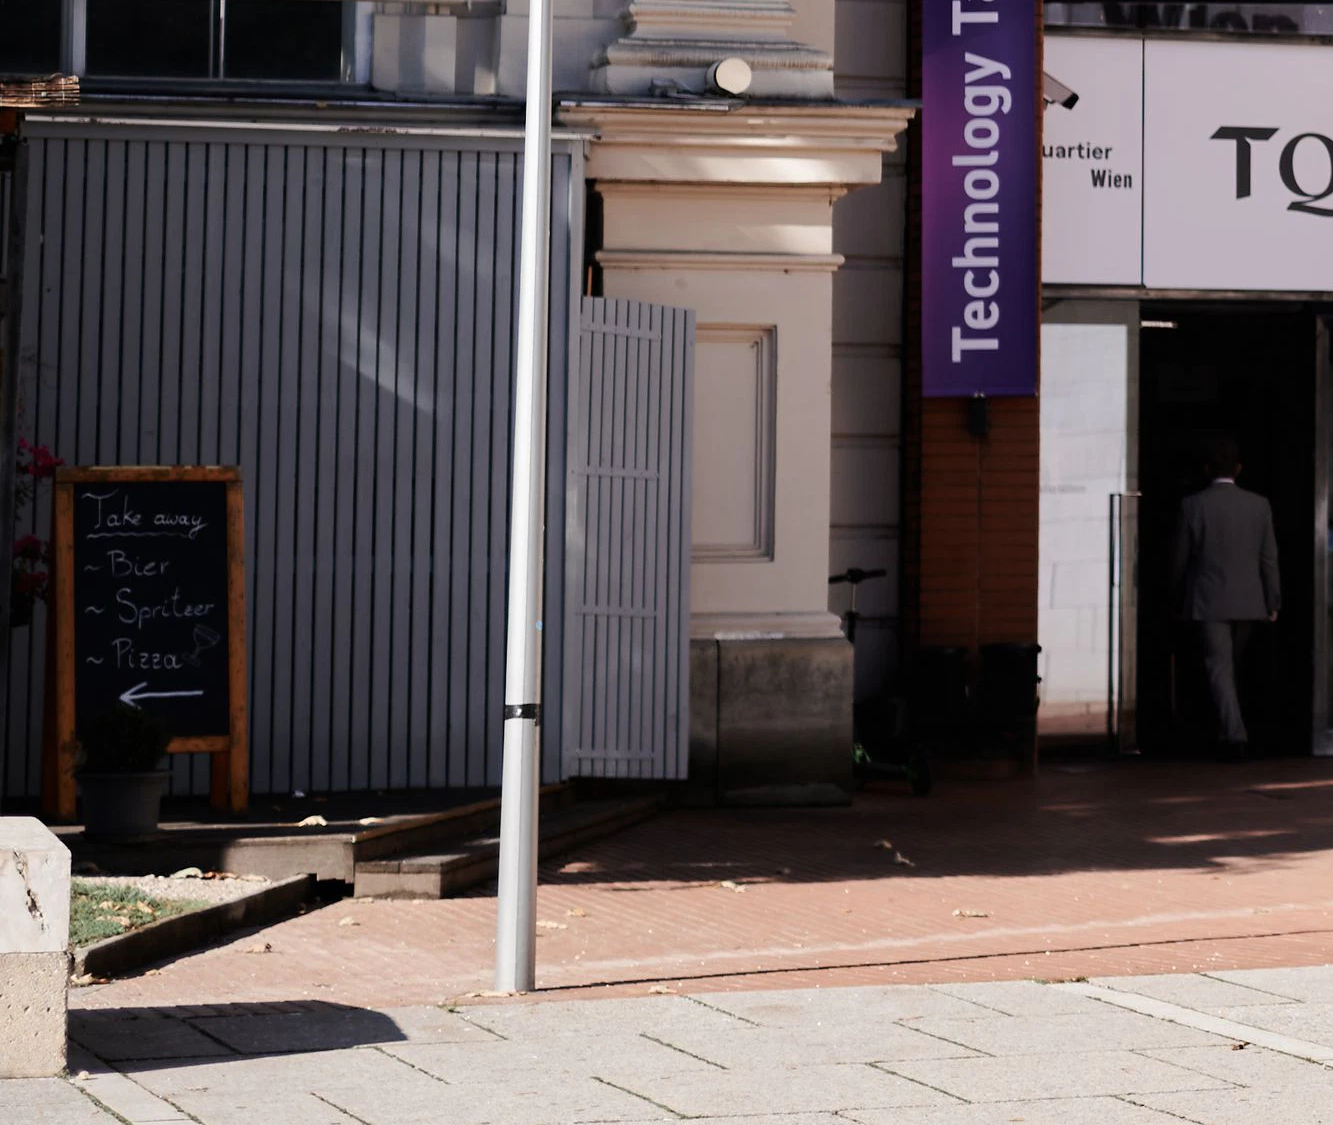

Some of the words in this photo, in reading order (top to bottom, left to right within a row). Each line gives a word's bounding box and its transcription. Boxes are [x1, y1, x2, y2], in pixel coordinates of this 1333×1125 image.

[1091, 168, 1133, 188] Wien
[952, 52, 1012, 363] Technology
[81, 489, 141, 529] Take
[154, 512, 208, 539] away
[107, 549, 169, 576] Bier
[116, 587, 215, 629] Spritzer
[112, 637, 183, 669] Pizza
